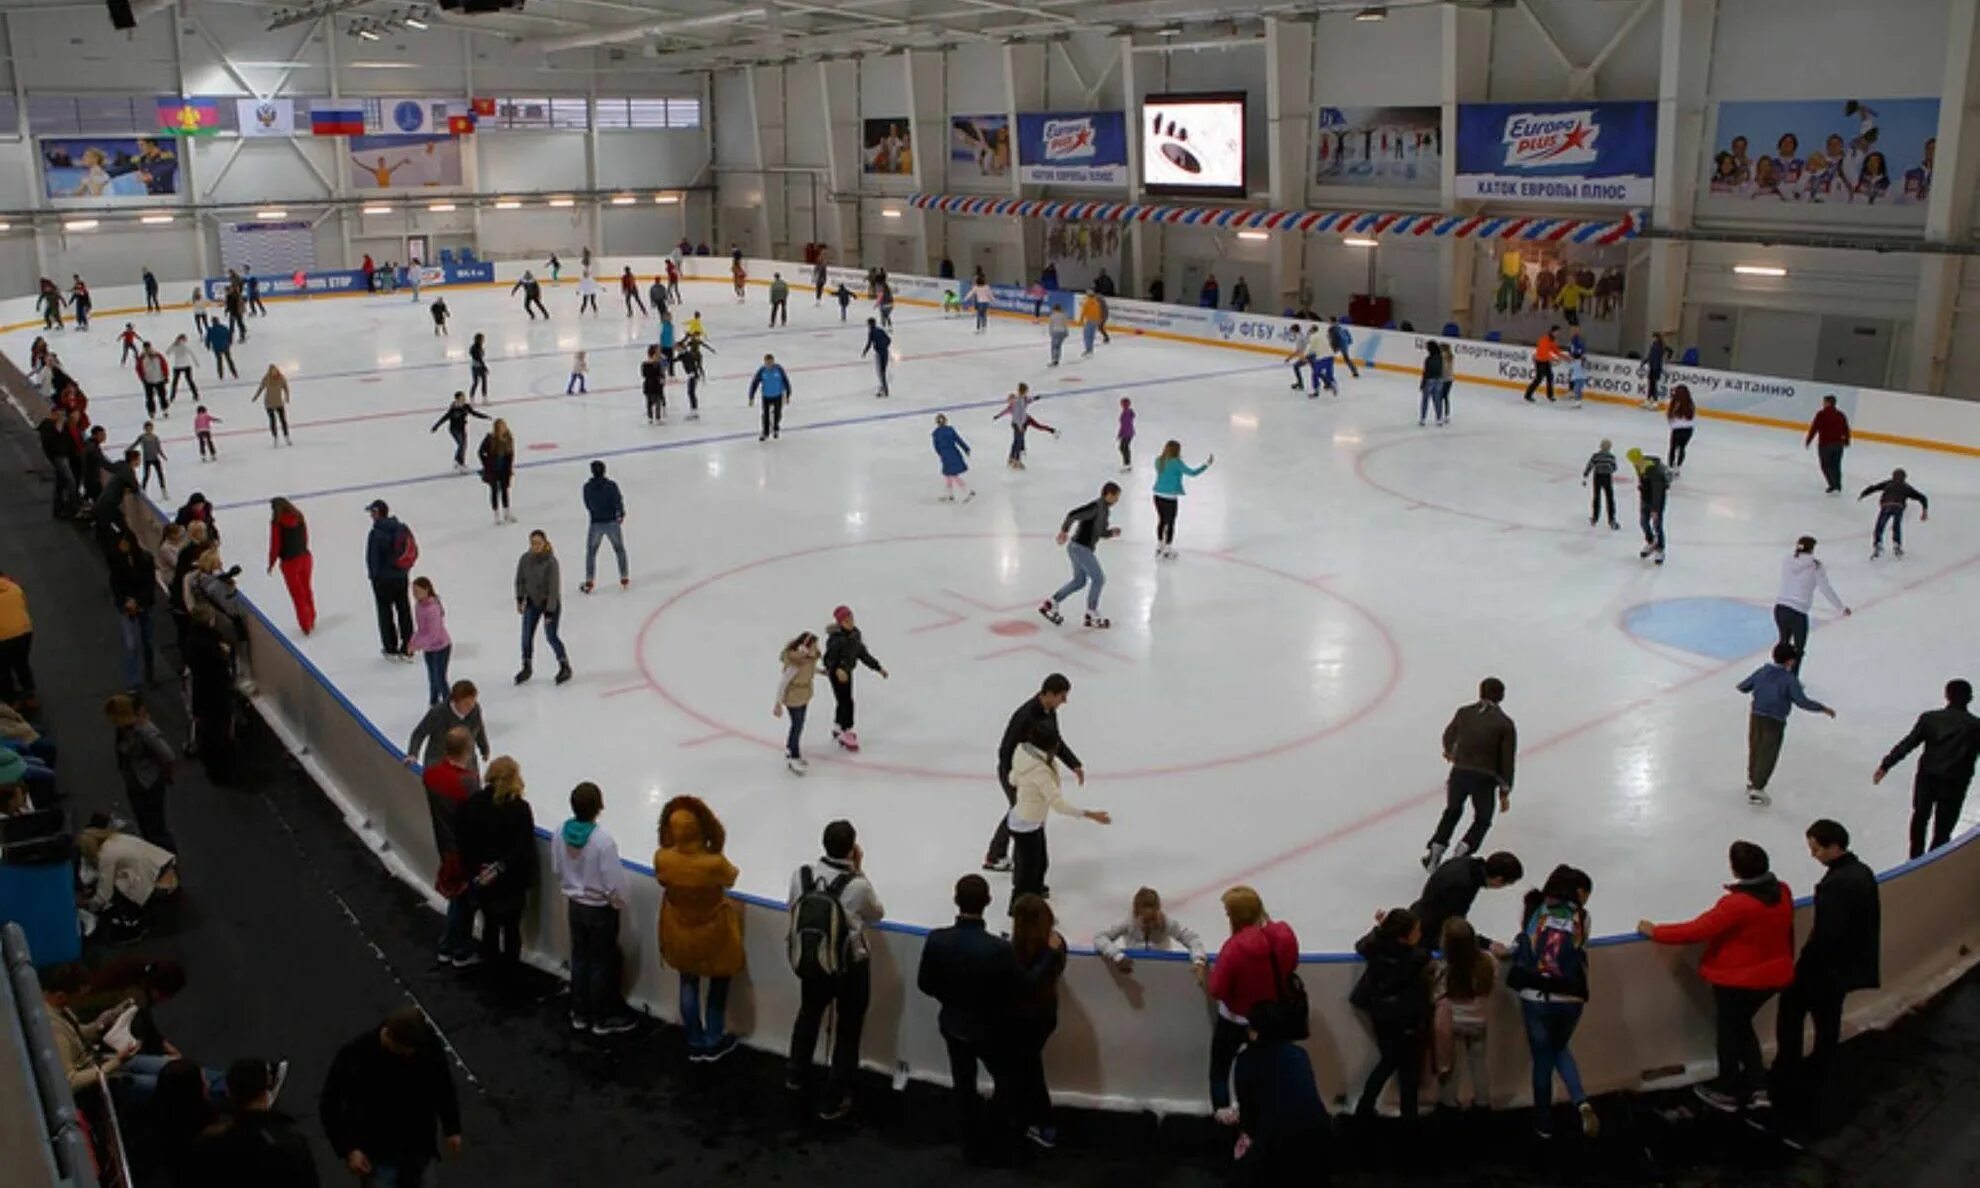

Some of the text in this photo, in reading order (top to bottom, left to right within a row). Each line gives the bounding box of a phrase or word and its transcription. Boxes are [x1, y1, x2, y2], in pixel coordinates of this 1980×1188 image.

[1477, 181, 1627, 199] КАТОК ЕВРОПЫ ПЛЮС
[1239, 321, 1274, 340] ФГБУ
[1454, 343, 1528, 362] спортивной
[1612, 363, 1631, 376] по
[1725, 377, 1796, 398] катанию
